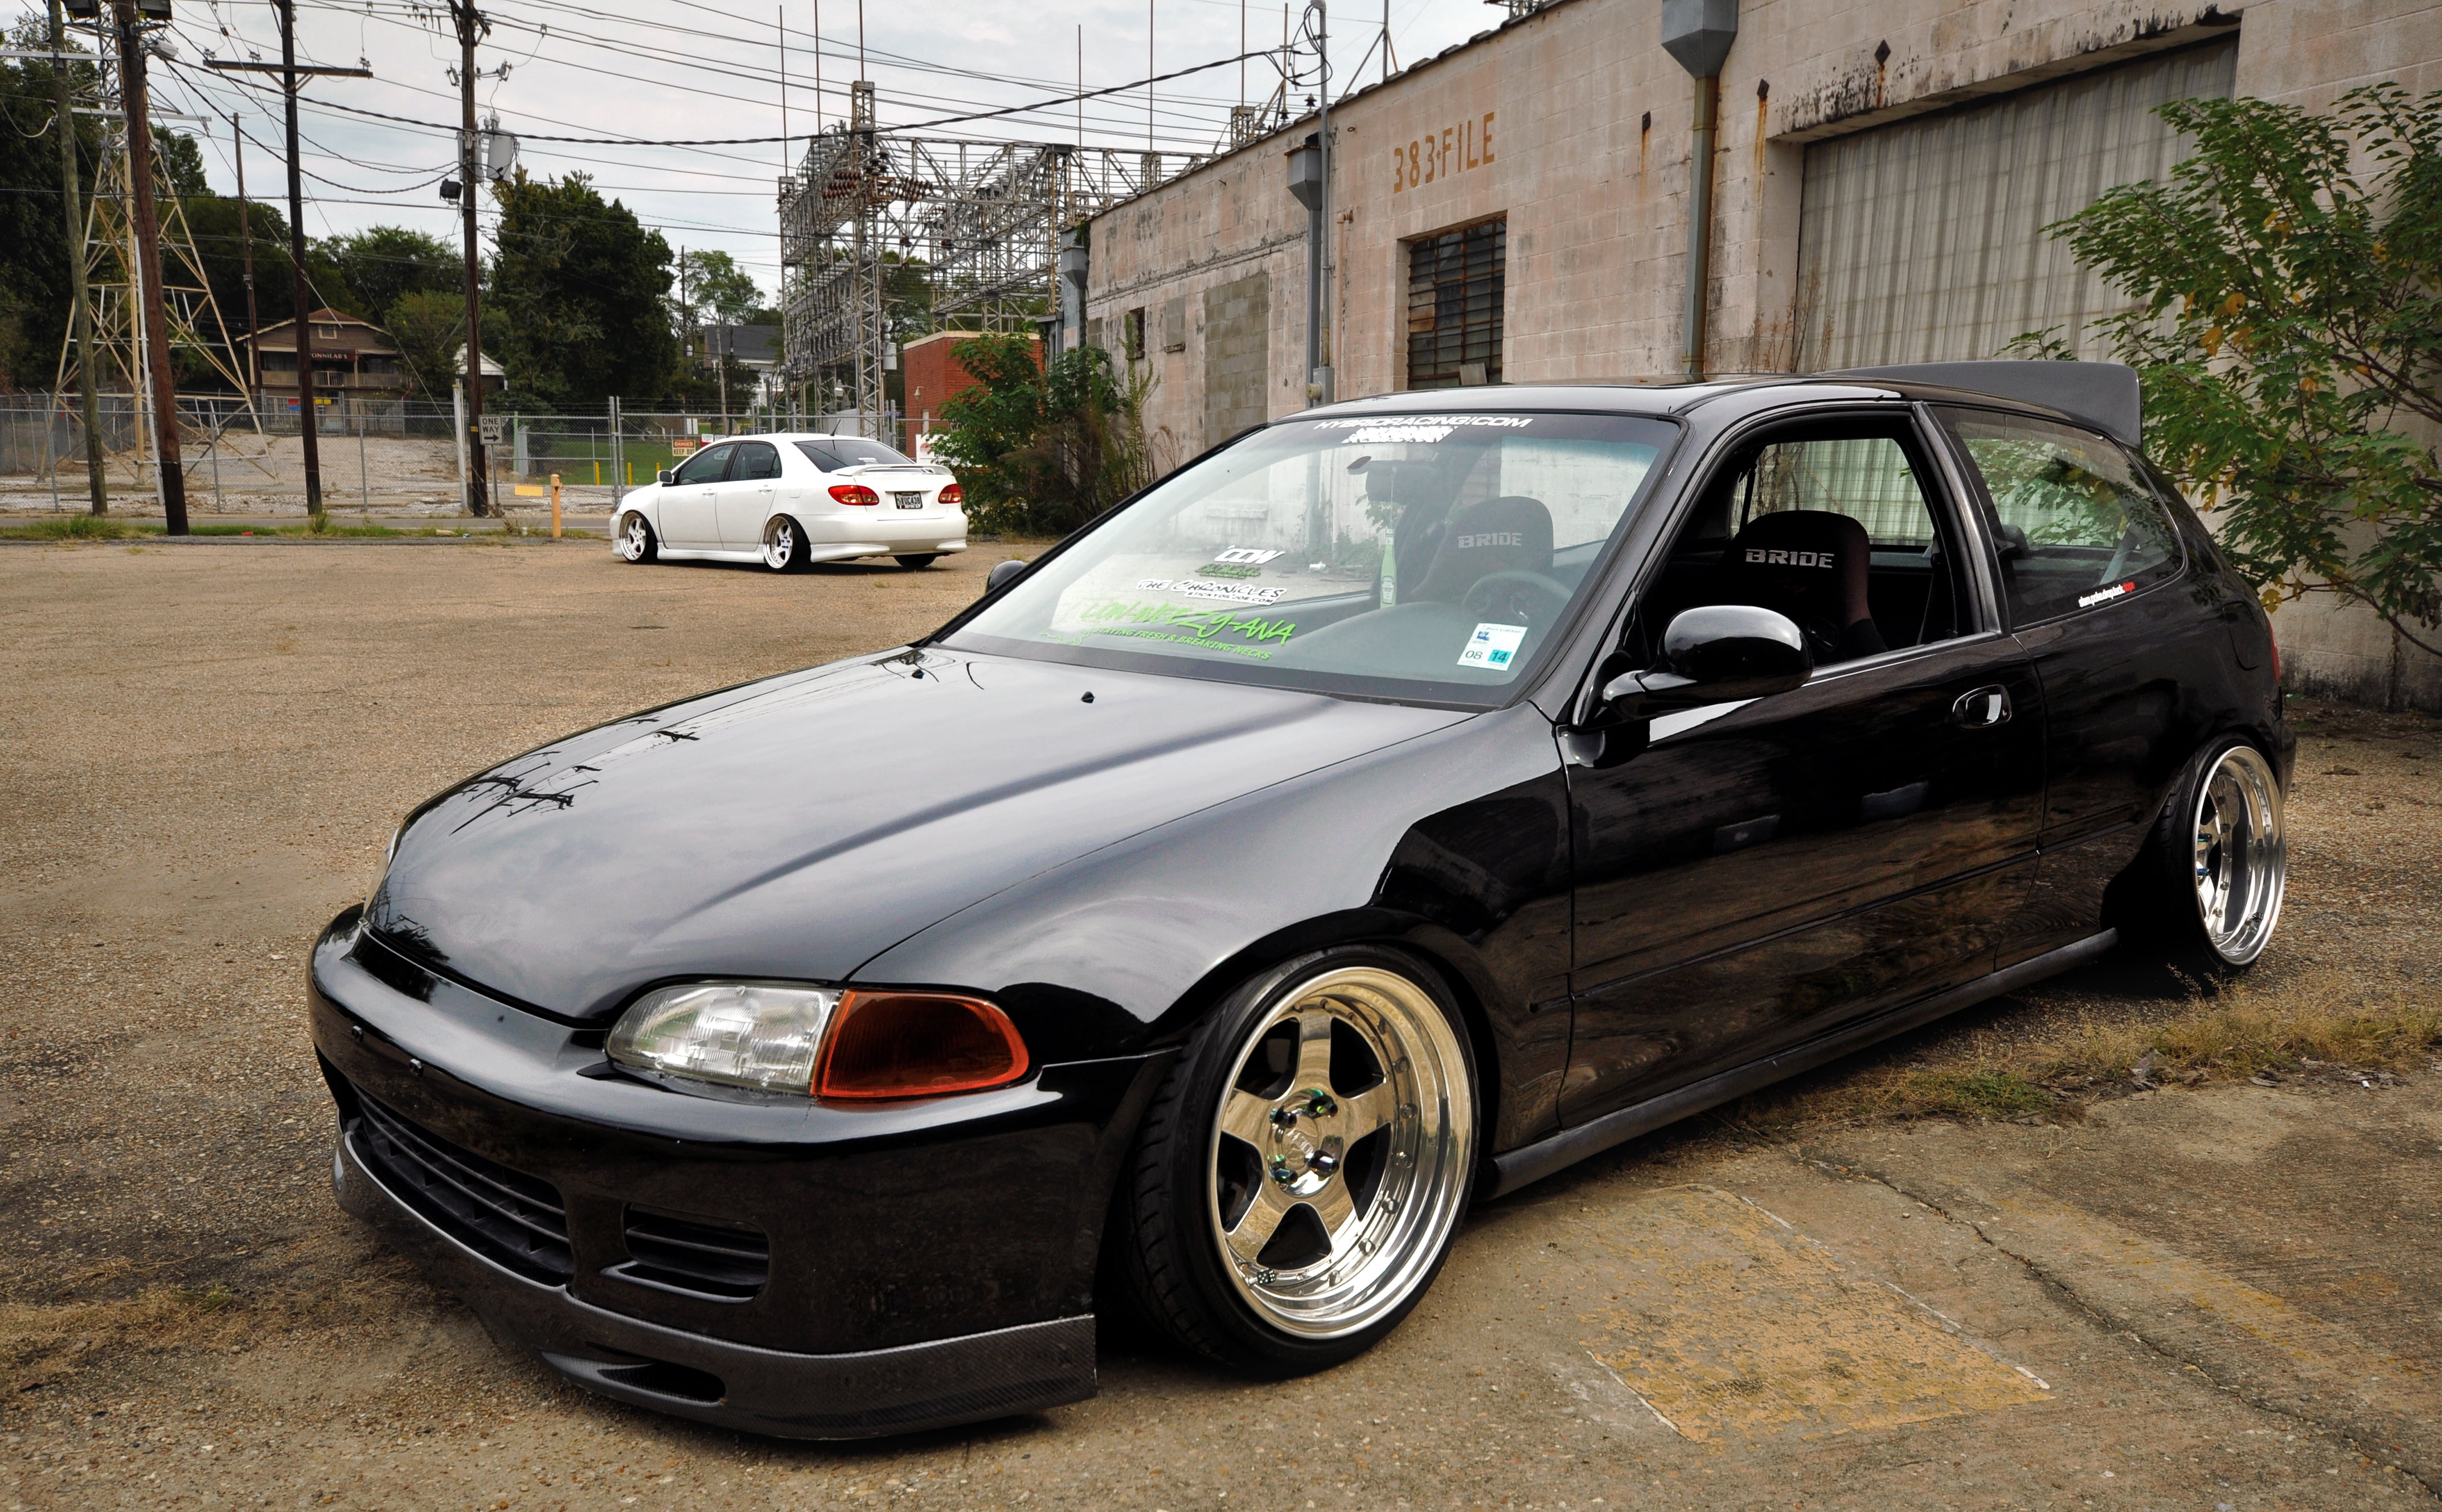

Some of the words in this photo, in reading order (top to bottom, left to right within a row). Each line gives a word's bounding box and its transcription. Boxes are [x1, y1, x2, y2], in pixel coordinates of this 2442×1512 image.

[1457, 532, 1522, 548] BRIDE
[1745, 548, 1835, 568] BRIDE
[1138, 580, 1169, 589] THE
[1173, 581, 1285, 598] CHRONICLES
[1135, 630, 1168, 640] FRESH
[1167, 634, 1177, 643] &
[1177, 636, 1234, 651] BREAKING
[1233, 645, 1272, 660] NECKS
[1465, 650, 1482, 659] 08
[1492, 651, 1507, 663] 14
